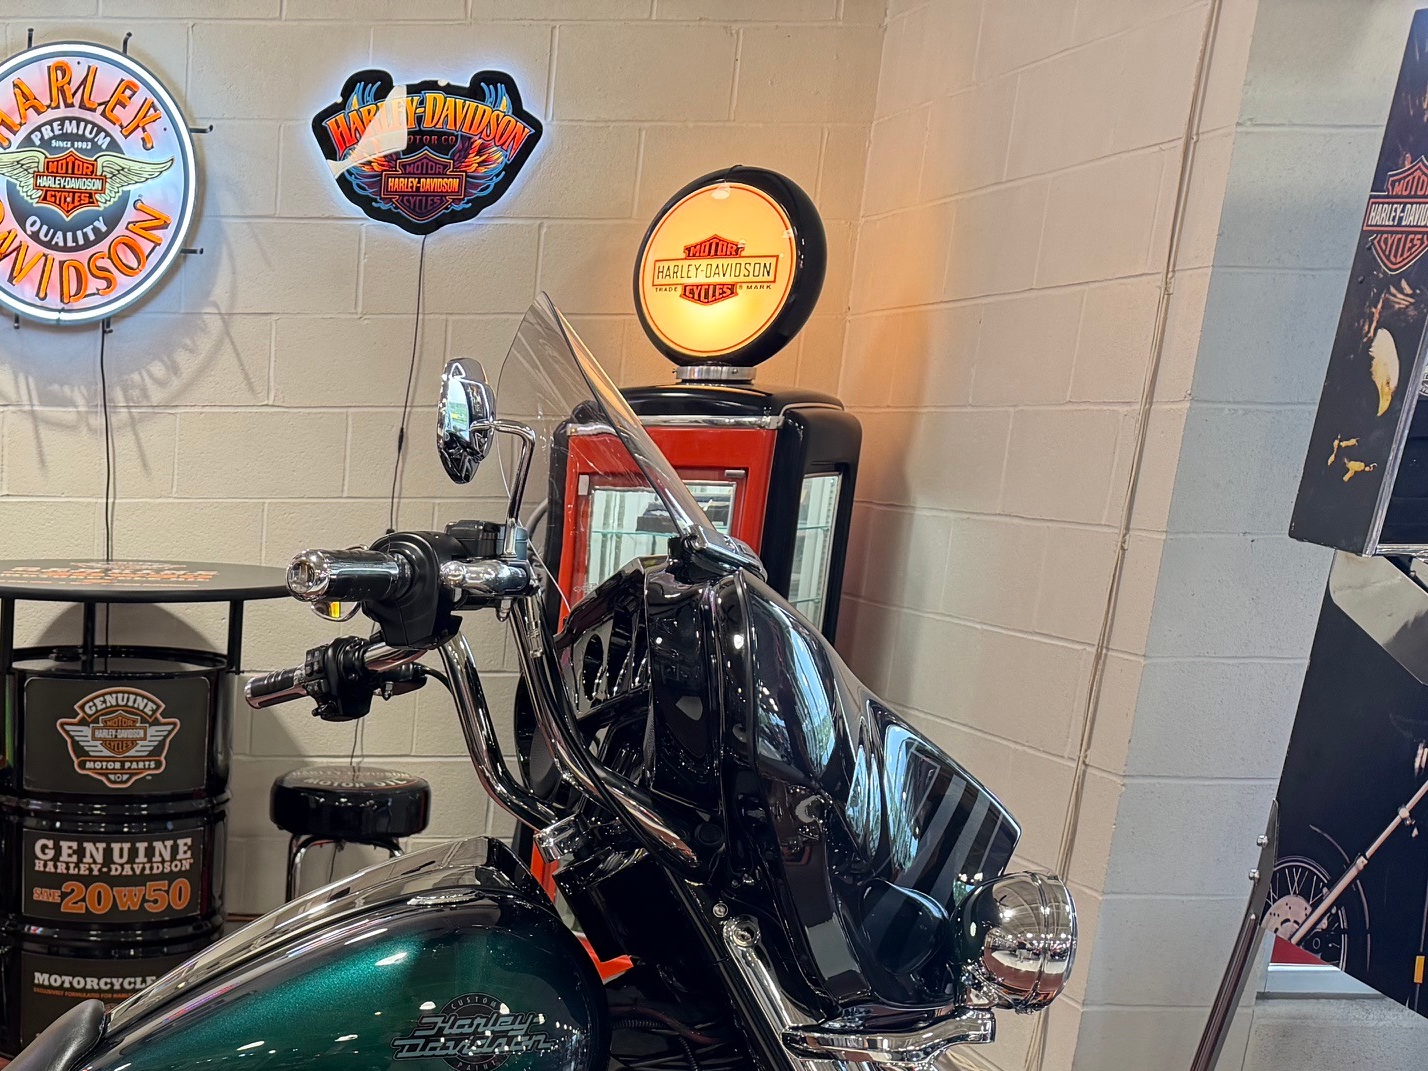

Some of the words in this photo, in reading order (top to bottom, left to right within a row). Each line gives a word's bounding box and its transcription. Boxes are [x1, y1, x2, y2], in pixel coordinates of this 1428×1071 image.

[30, 118, 112, 150] PREMIUM
[50, 138, 73, 149] SINCE
[73, 139, 93, 150] 1903
[45, 156, 97, 176] MOTOR
[405, 159, 445, 175] MOTOR
[36, 175, 104, 191] HARLEY-DAVIDSON
[387, 178, 460, 192] HARLEY-DAVIDSON
[1392, 169, 1428, 195] MOTO
[45, 191, 92, 206] CYCLES
[402, 196, 443, 212] CYCLES
[24, 215, 110, 248] QUALITY
[687, 238, 738, 257] MOTOR
[1380, 234, 1422, 263] CYCLES
[656, 261, 773, 280] HARLEY-DAVIDSON
[685, 284, 732, 303] CYCLES
[84, 692, 158, 716] GENUINE
[106, 717, 134, 727] MOTOR
[94, 728, 145, 739] HARLEY-DAVIDSON
[105, 740, 133, 752] CYCLES
[85, 761, 122, 770] MOTOR
[124, 761, 156, 770] PARTS
[303, 777, 366, 788] MOTOR
[373, 778, 408, 787] OIL
[34, 837, 194, 864] GENUINE
[32, 887, 61, 903] SAE
[450, 996, 498, 1011] CUSTOM
[392, 1032, 558, 1058] Davidson
[456, 1059, 498, 1071] PAINT
